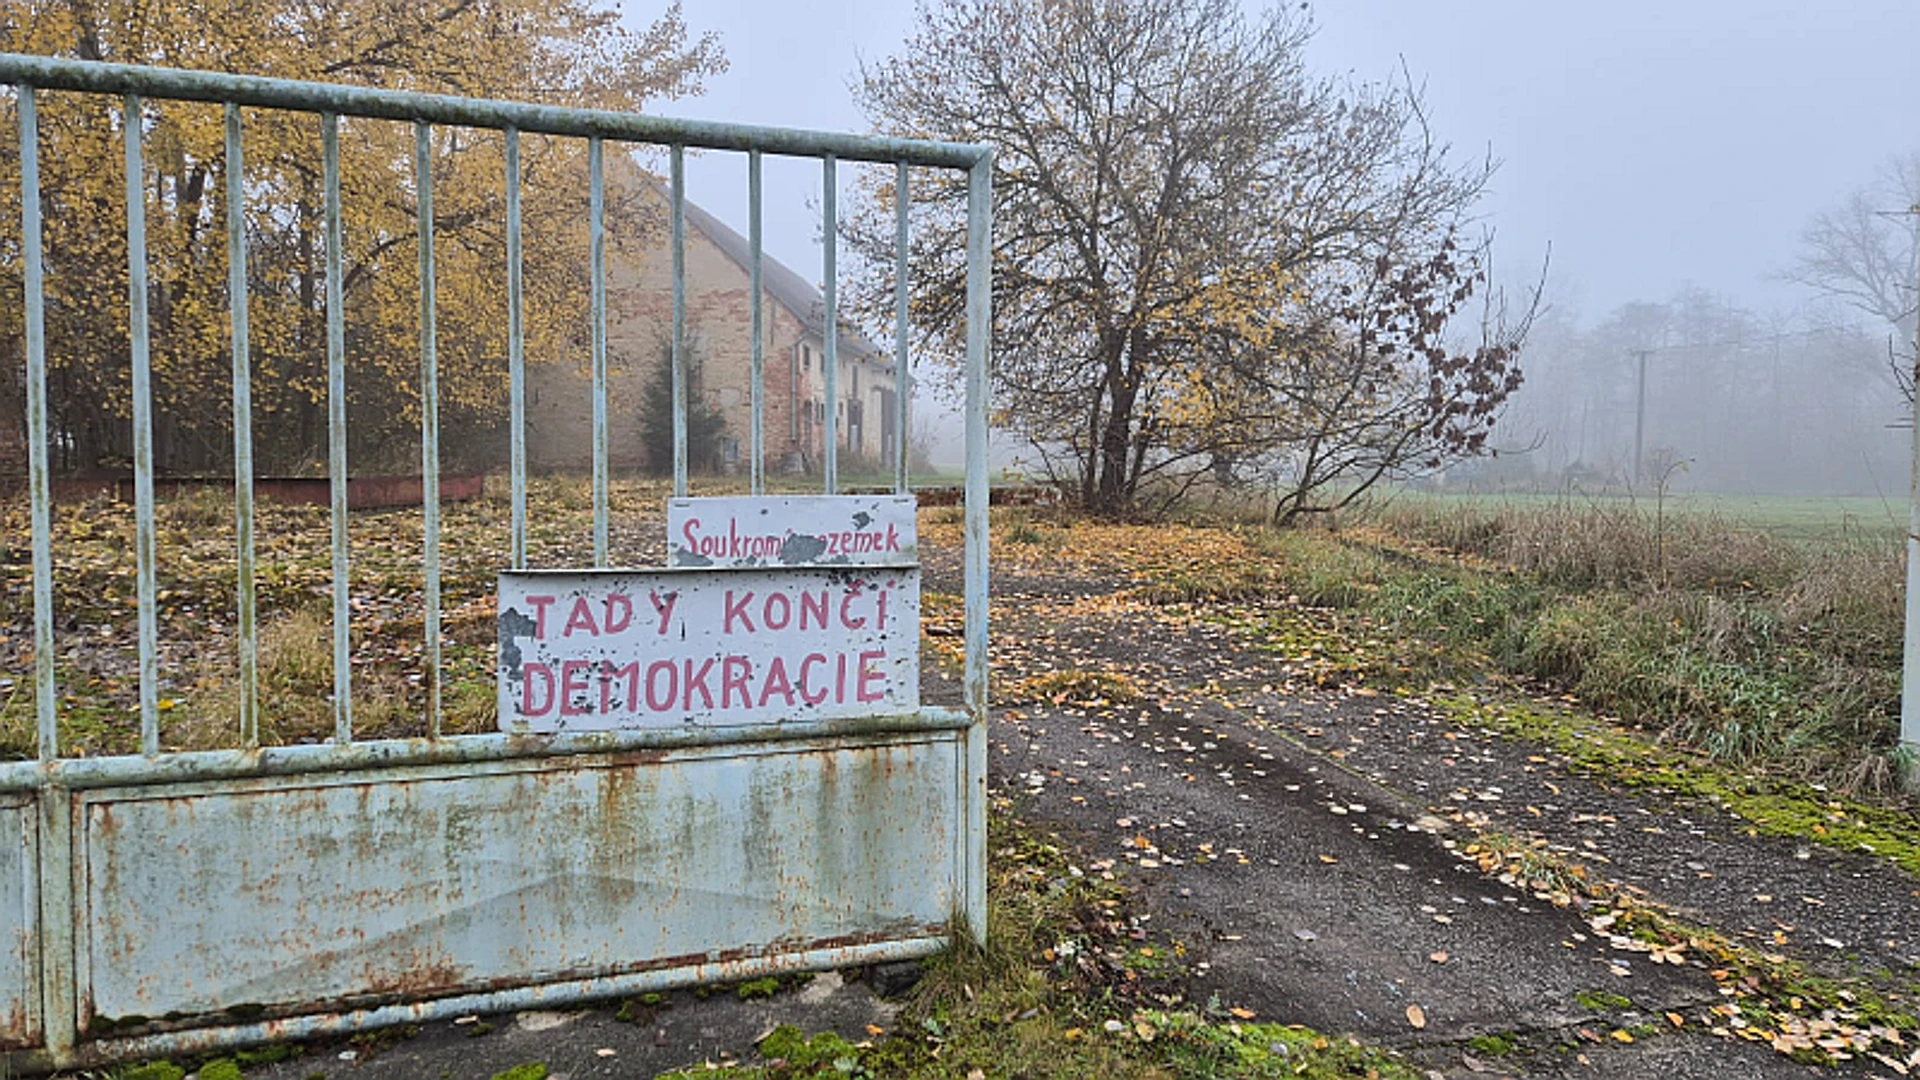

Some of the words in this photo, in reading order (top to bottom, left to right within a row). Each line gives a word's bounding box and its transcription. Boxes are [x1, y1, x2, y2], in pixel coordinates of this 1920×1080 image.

[807, 523, 900, 556] zemek
[526, 589, 678, 640] TADY
[723, 579, 896, 634] KONČÍ
[521, 652, 887, 717] DEMOKRACIE
